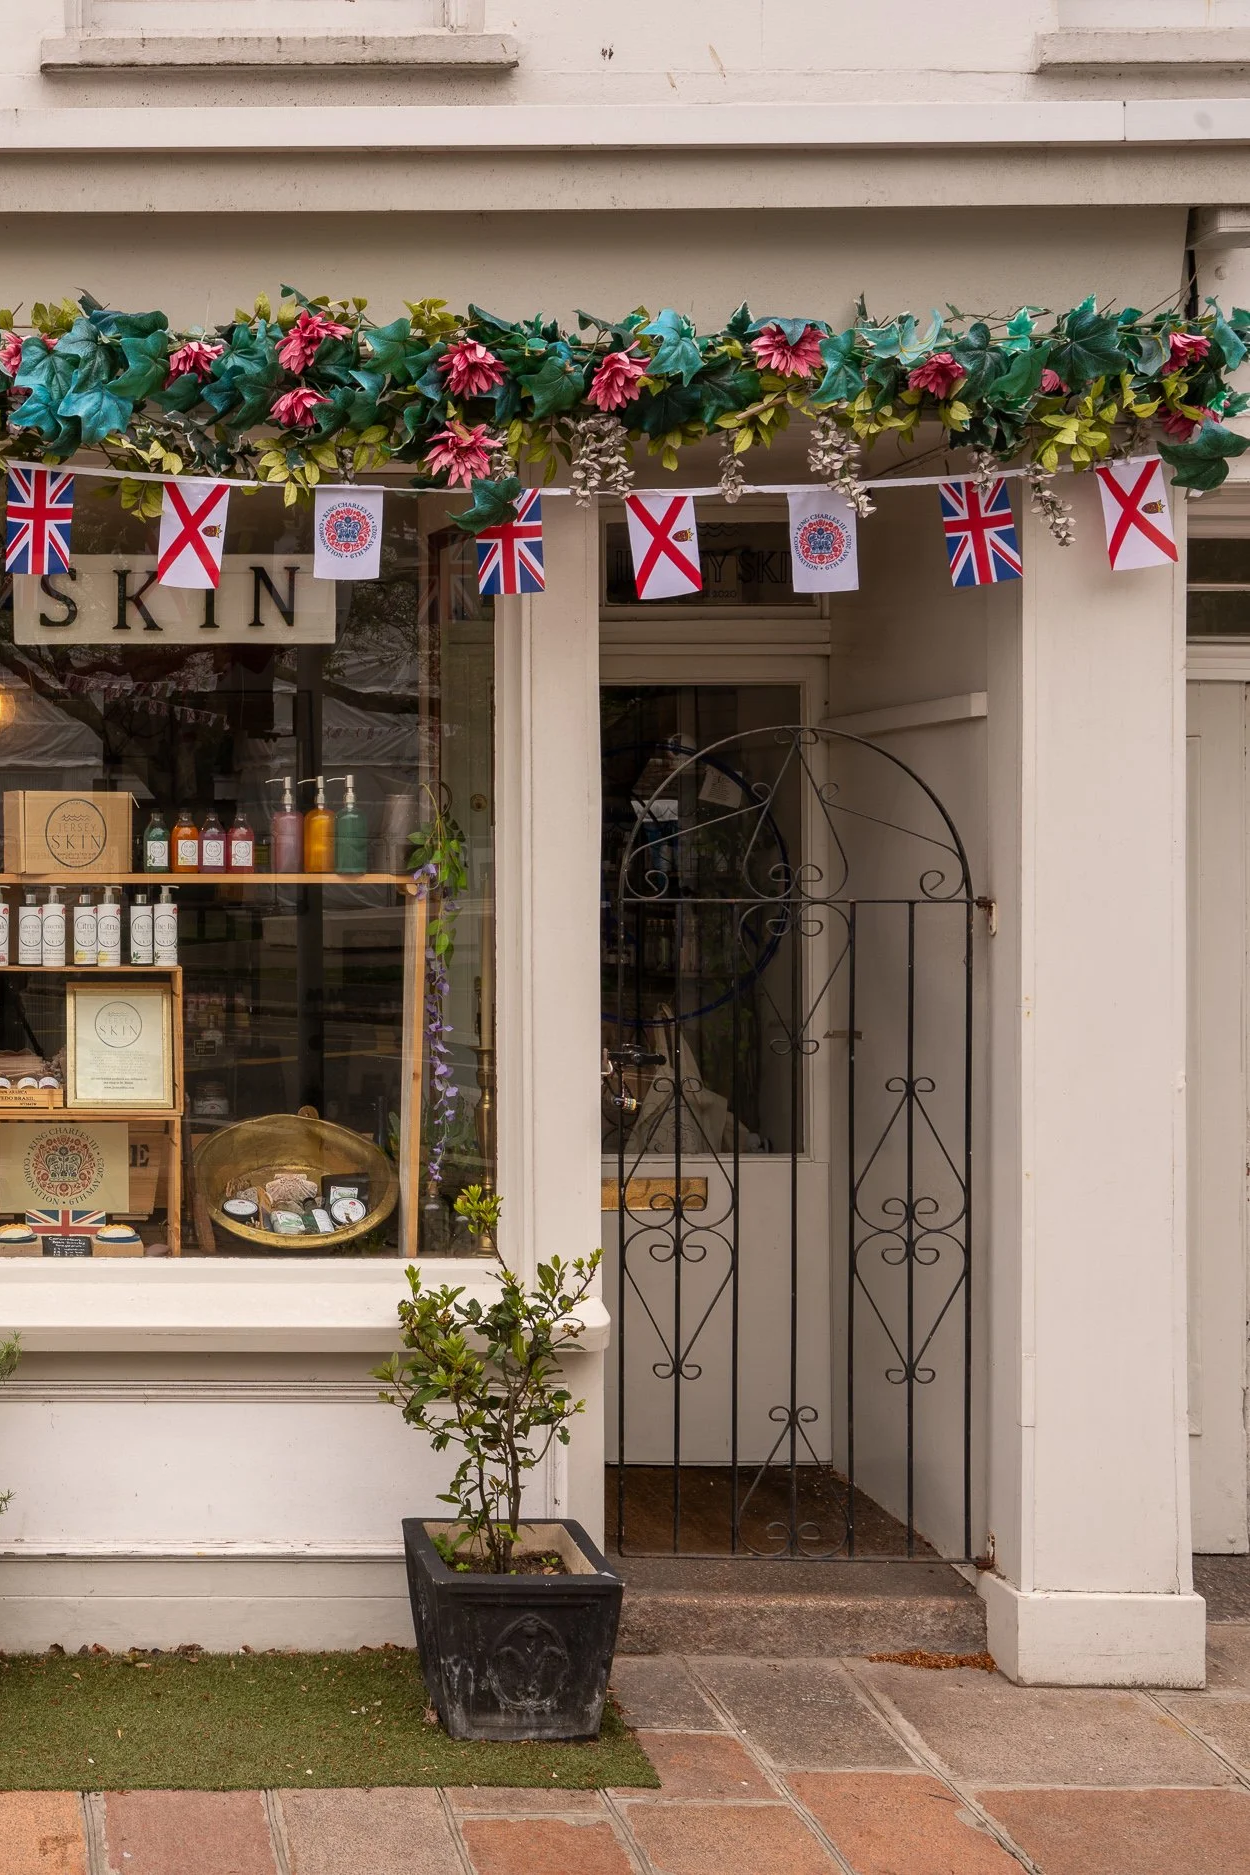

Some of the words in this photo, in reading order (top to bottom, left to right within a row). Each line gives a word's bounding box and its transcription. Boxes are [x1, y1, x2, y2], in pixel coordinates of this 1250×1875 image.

[322, 504, 338, 518] KING
[338, 502, 367, 514] CHARLES
[796, 517, 810, 531] KING
[810, 513, 840, 524] CHARLES
[838, 522, 848, 530] III
[319, 523, 343, 558] CORONATION
[364, 540, 374, 552] MAY
[794, 536, 818, 570] CORONATION
[838, 550, 850, 563] MAY
[40, 566, 300, 631] SKIN
[58, 822, 96, 833] JERSEY
[51, 834, 101, 849] SKIN
[99, 1025, 138, 1036] SKIN
[28, 1132, 48, 1151] KING
[48, 1128, 91, 1140] CHARLES
[89, 1139, 100, 1151] III
[24, 1158, 60, 1205] CORONATION
[69, 1194, 87, 1206] 6TH
[86, 1180, 101, 1197] MAY
